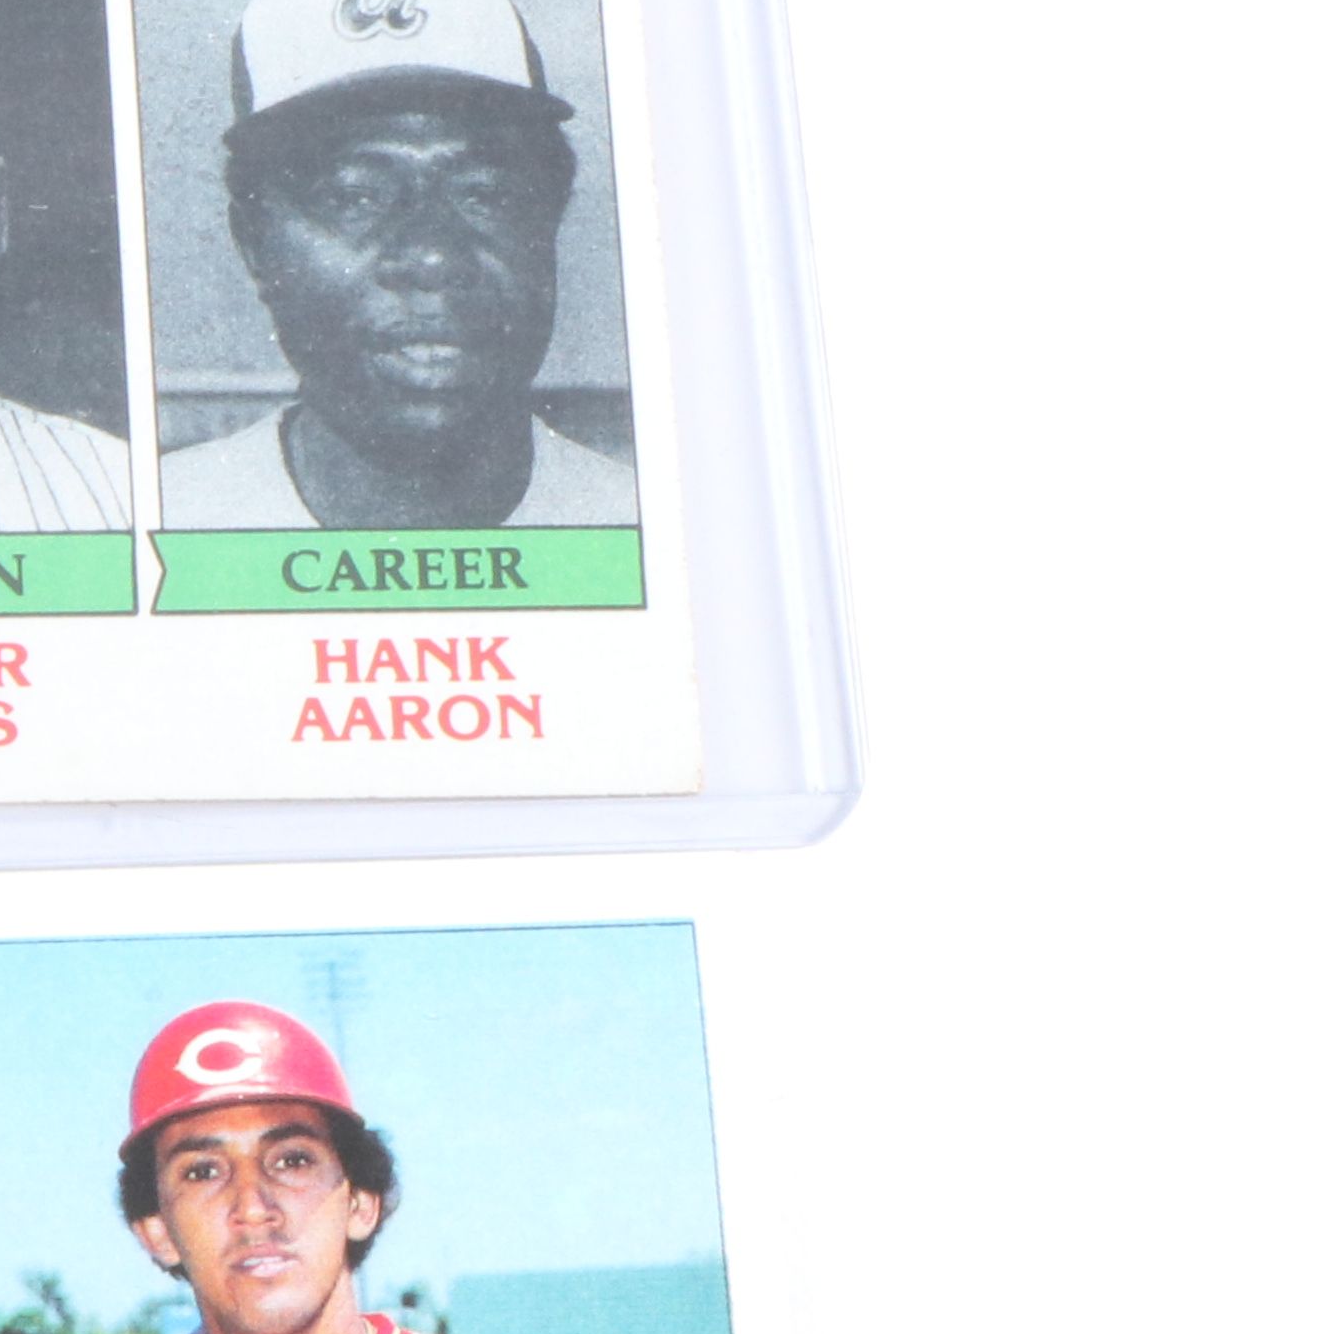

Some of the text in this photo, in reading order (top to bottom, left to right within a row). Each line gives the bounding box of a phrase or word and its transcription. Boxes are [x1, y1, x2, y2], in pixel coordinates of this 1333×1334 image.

[280, 546, 528, 595] CAREER
[312, 635, 516, 684] HANK
[290, 692, 545, 743] AARON
[173, 1027, 263, 1087] C
